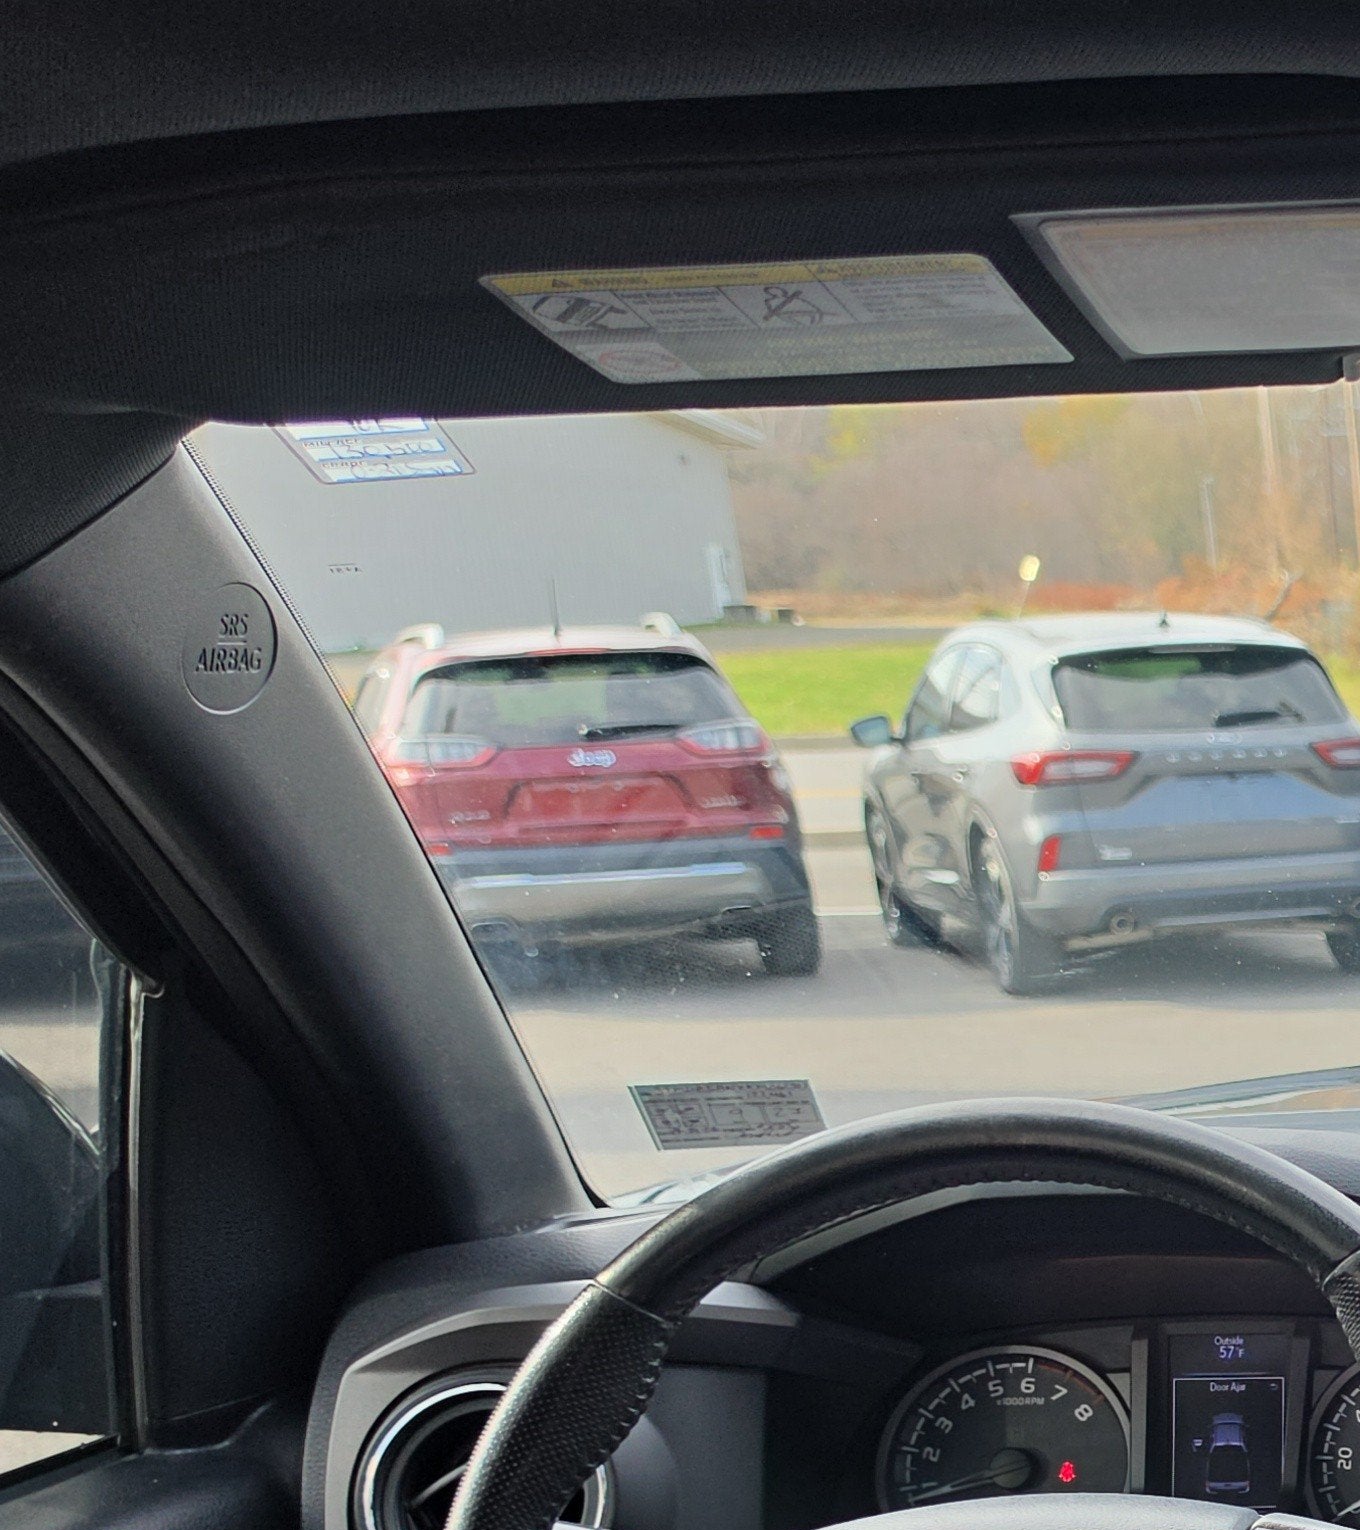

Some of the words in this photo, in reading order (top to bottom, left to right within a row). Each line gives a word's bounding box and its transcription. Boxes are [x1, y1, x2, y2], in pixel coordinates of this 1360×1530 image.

[219, 613, 249, 638] SRS
[195, 646, 262, 673] AIRBAG
[1214, 1335, 1245, 1346] Outside
[988, 1380, 1004, 1397] 5
[1021, 1378, 1036, 1393] 6
[1050, 1384, 1068, 1400] 7
[1209, 1381, 1229, 1392] Door
[1230, 1381, 1247, 1393] Ajar
[960, 1393, 975, 1410] 4
[1074, 1404, 1094, 1422] 8
[934, 1416, 954, 1433] 3
[922, 1446, 941, 1462] 2
[1337, 1447, 1353, 1471] 20
